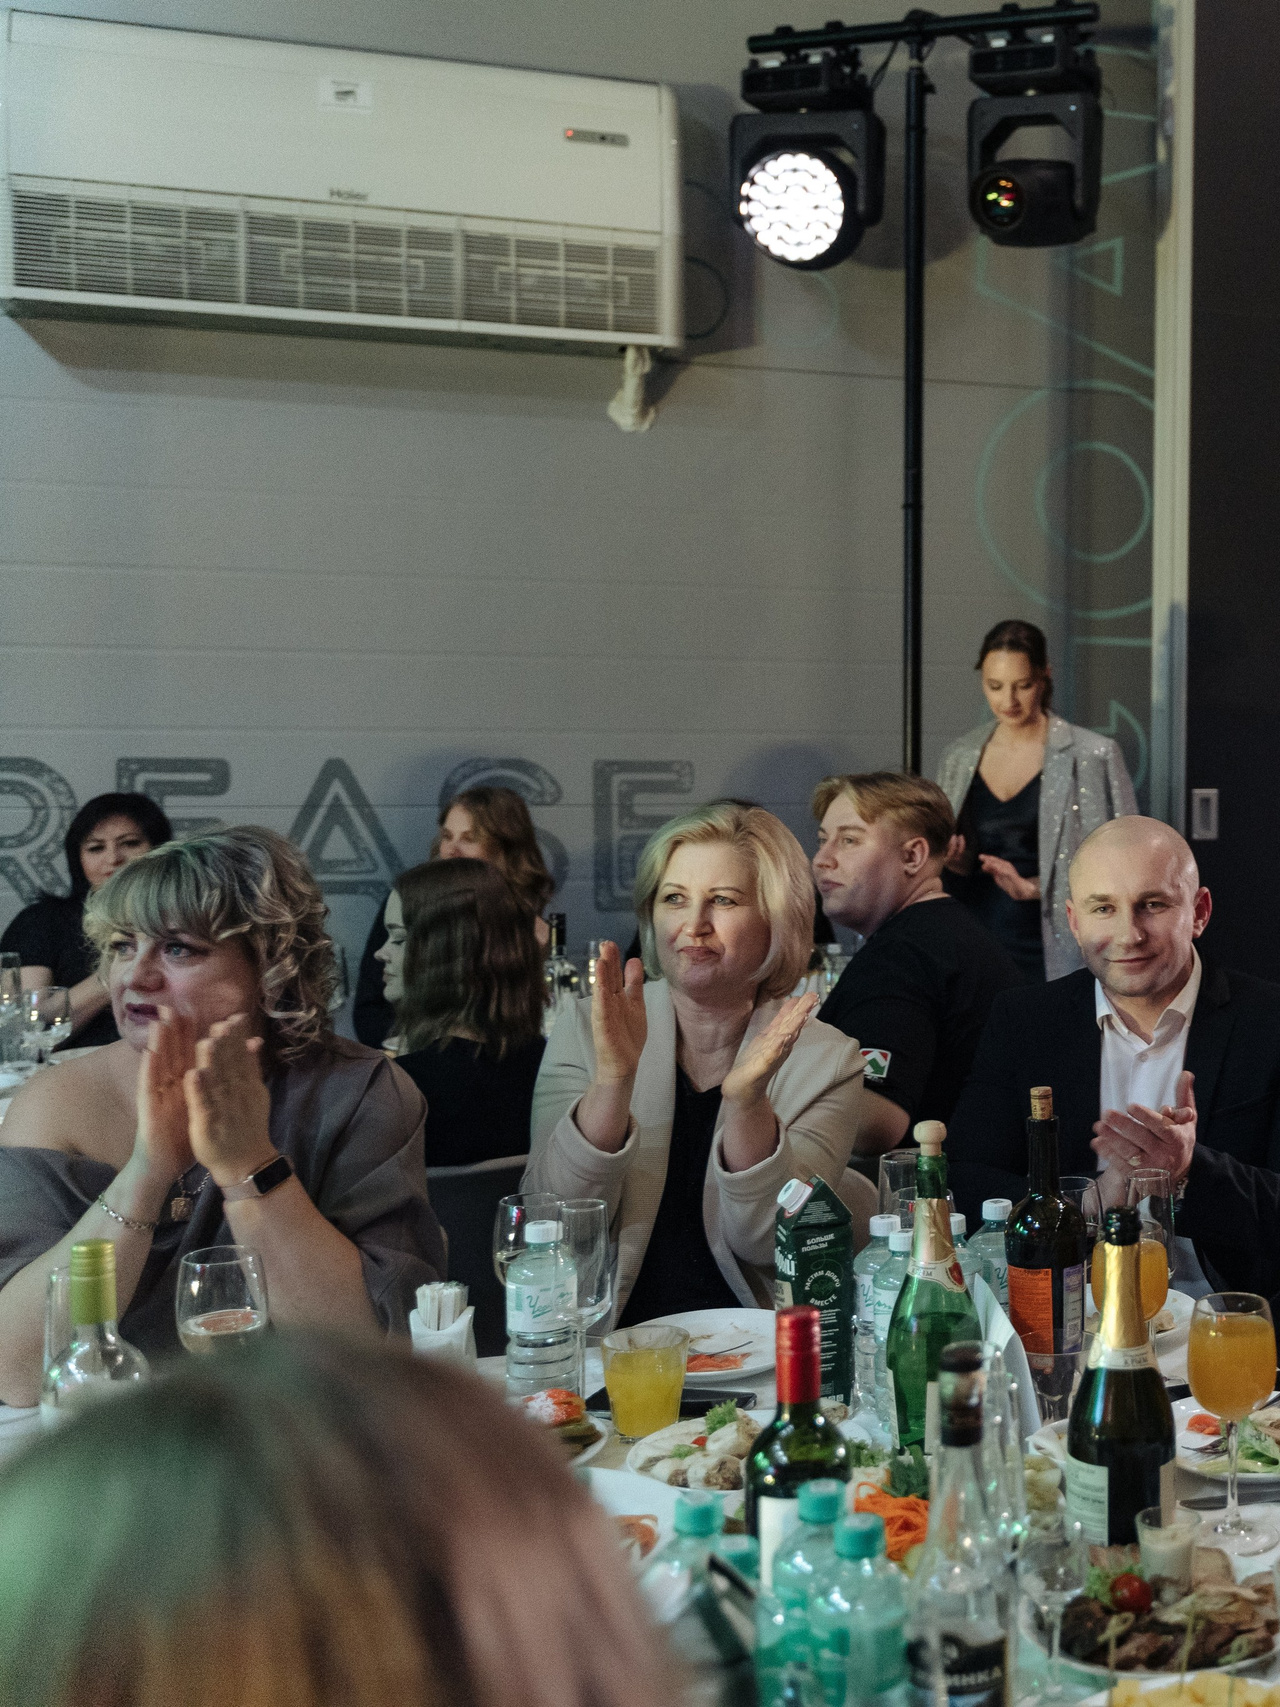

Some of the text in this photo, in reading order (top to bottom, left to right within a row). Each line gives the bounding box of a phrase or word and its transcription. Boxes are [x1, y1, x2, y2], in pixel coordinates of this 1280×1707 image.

[806, 1233, 835, 1245] БОЛЬШЕ
[801, 1242, 828, 1252] ПОЛЬЗЫ
[804, 1270, 841, 1291] РАСТИМ ДОБРО
[809, 1293, 838, 1307] ВМЕСТЕ
